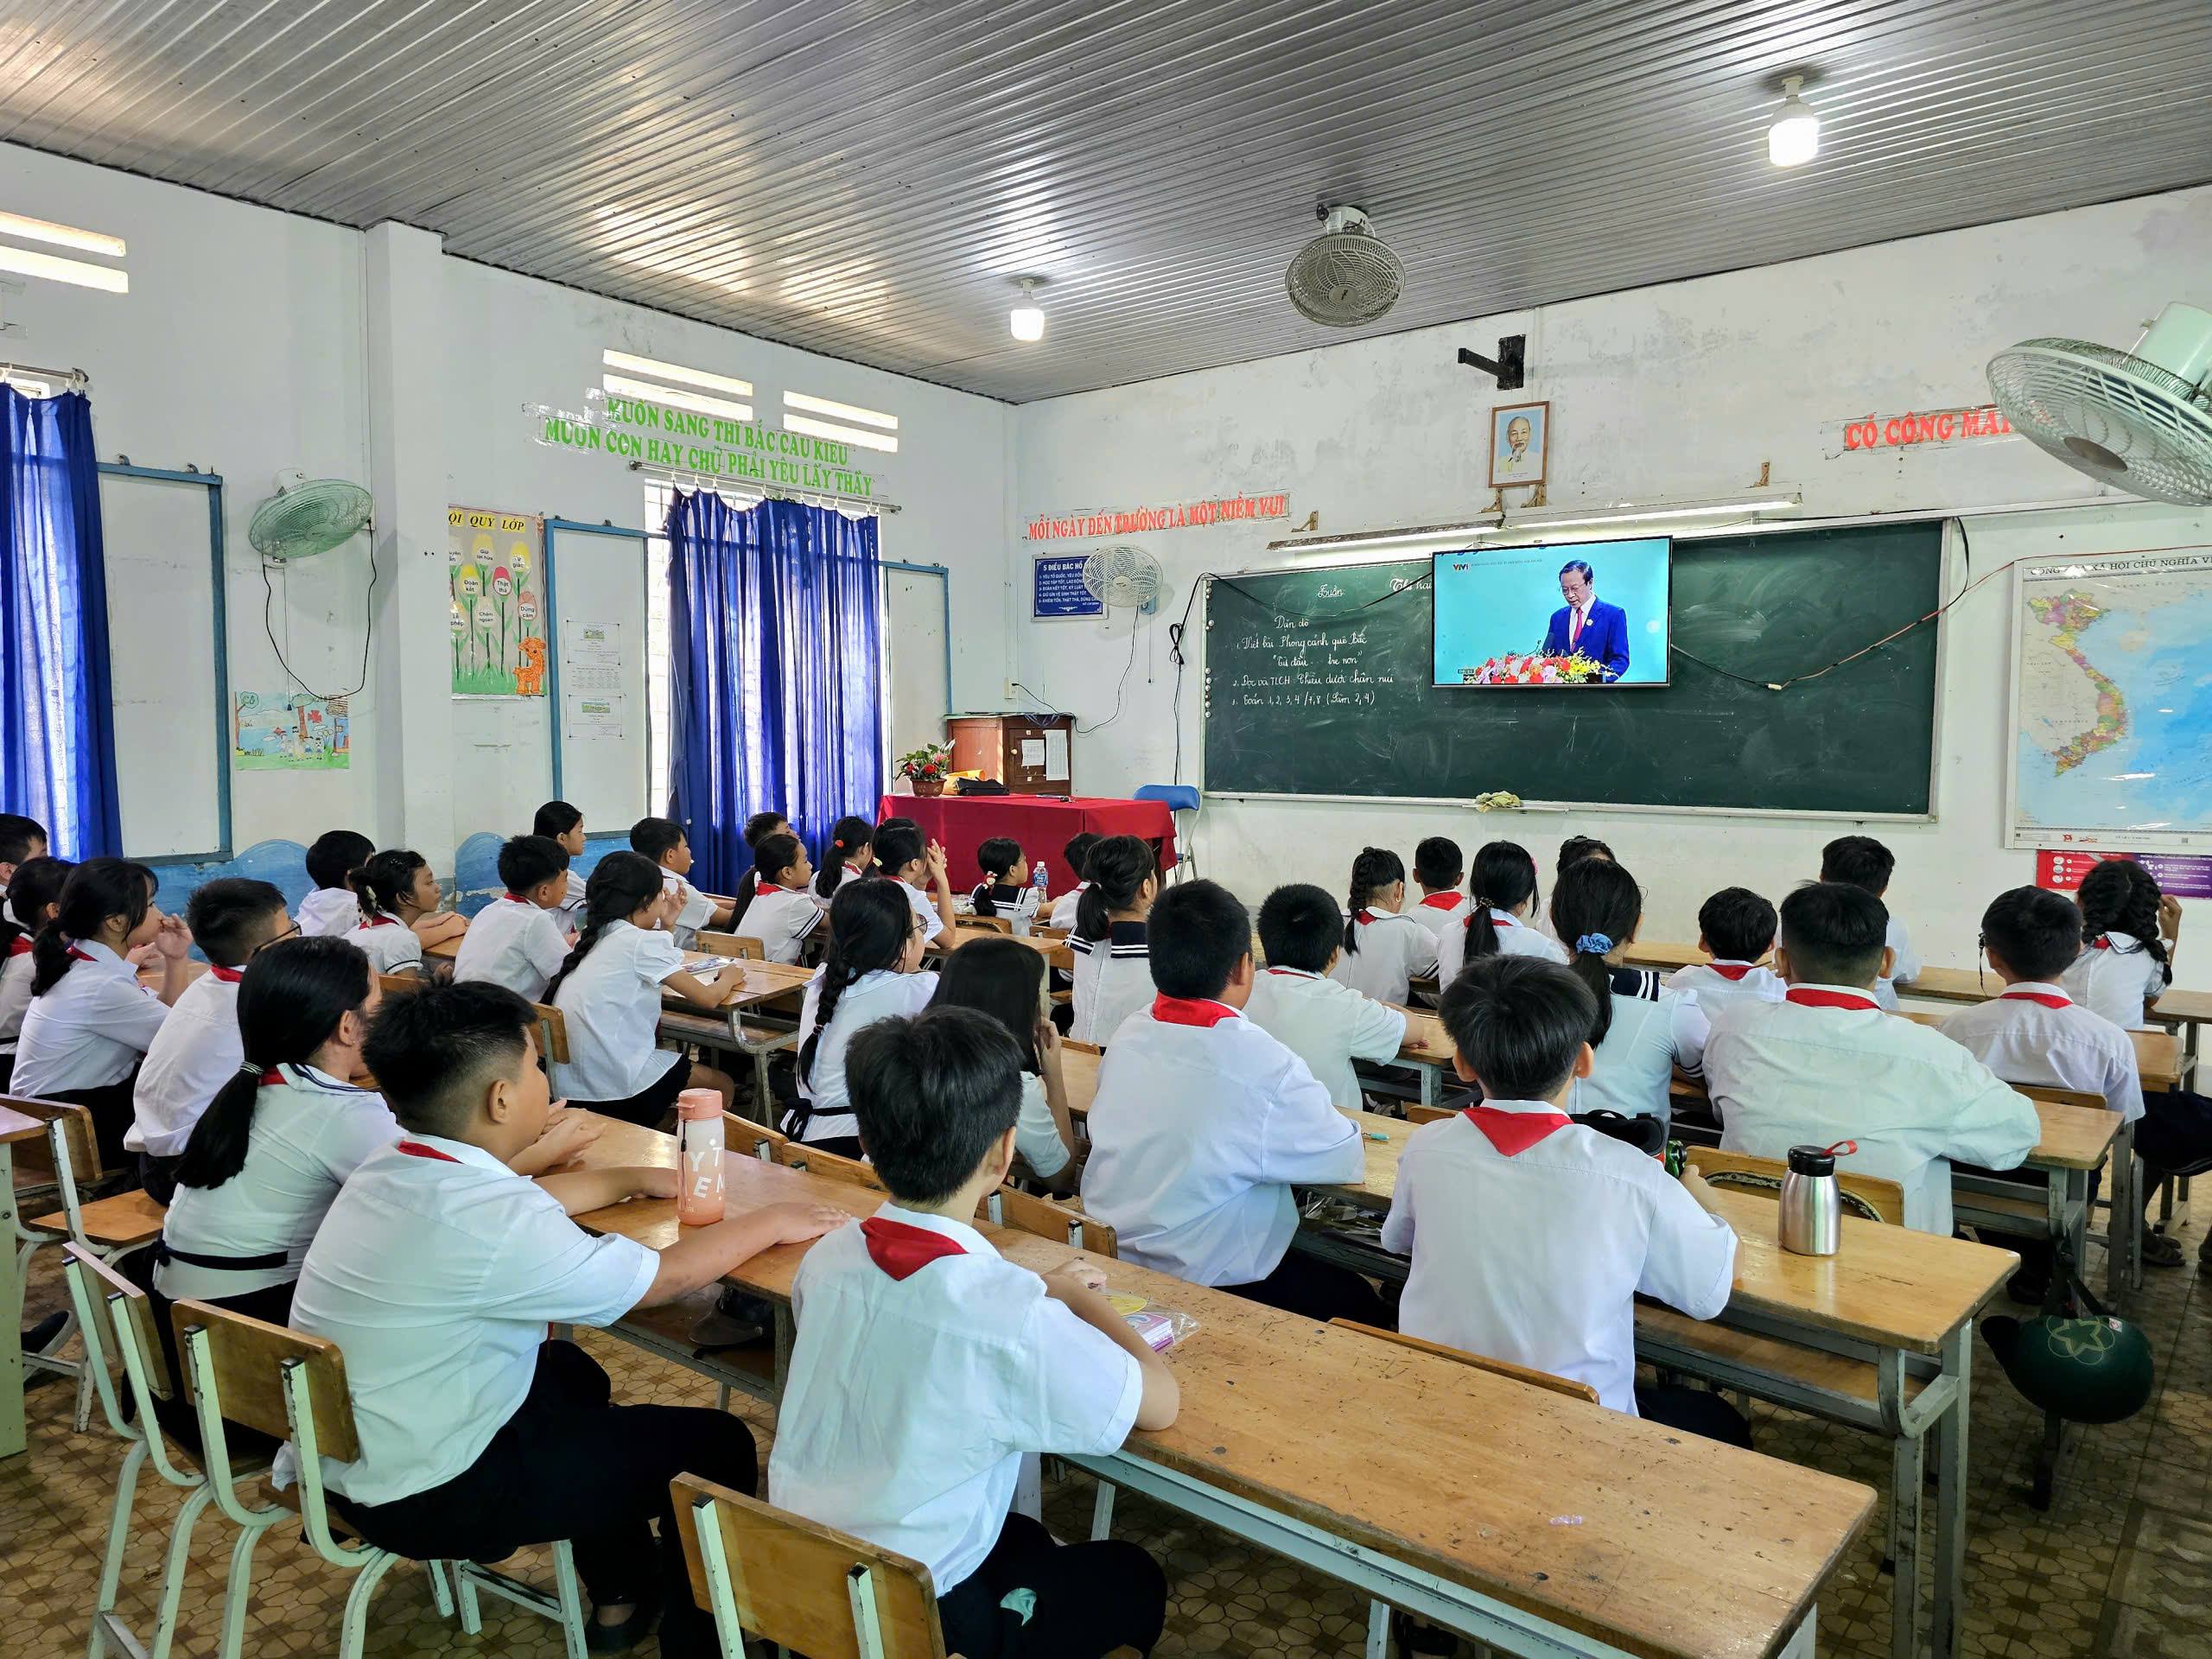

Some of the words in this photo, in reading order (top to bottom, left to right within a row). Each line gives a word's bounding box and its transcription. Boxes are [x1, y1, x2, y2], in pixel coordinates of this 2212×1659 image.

[664, 409, 709, 438] SANG
[1885, 411, 1955, 445] CÔNG
[606, 429, 643, 458] CON
[648, 438, 683, 466] HAY
[769, 457, 799, 484] YÊU
[501, 518, 524, 531] LỚP
[1052, 514, 1085, 538] NGÀY
[1089, 509, 1112, 536] ĐẾN
[1168, 503, 1185, 527] LÀ
[1189, 500, 1217, 527] MỘT
[1259, 494, 1285, 517] VUI
